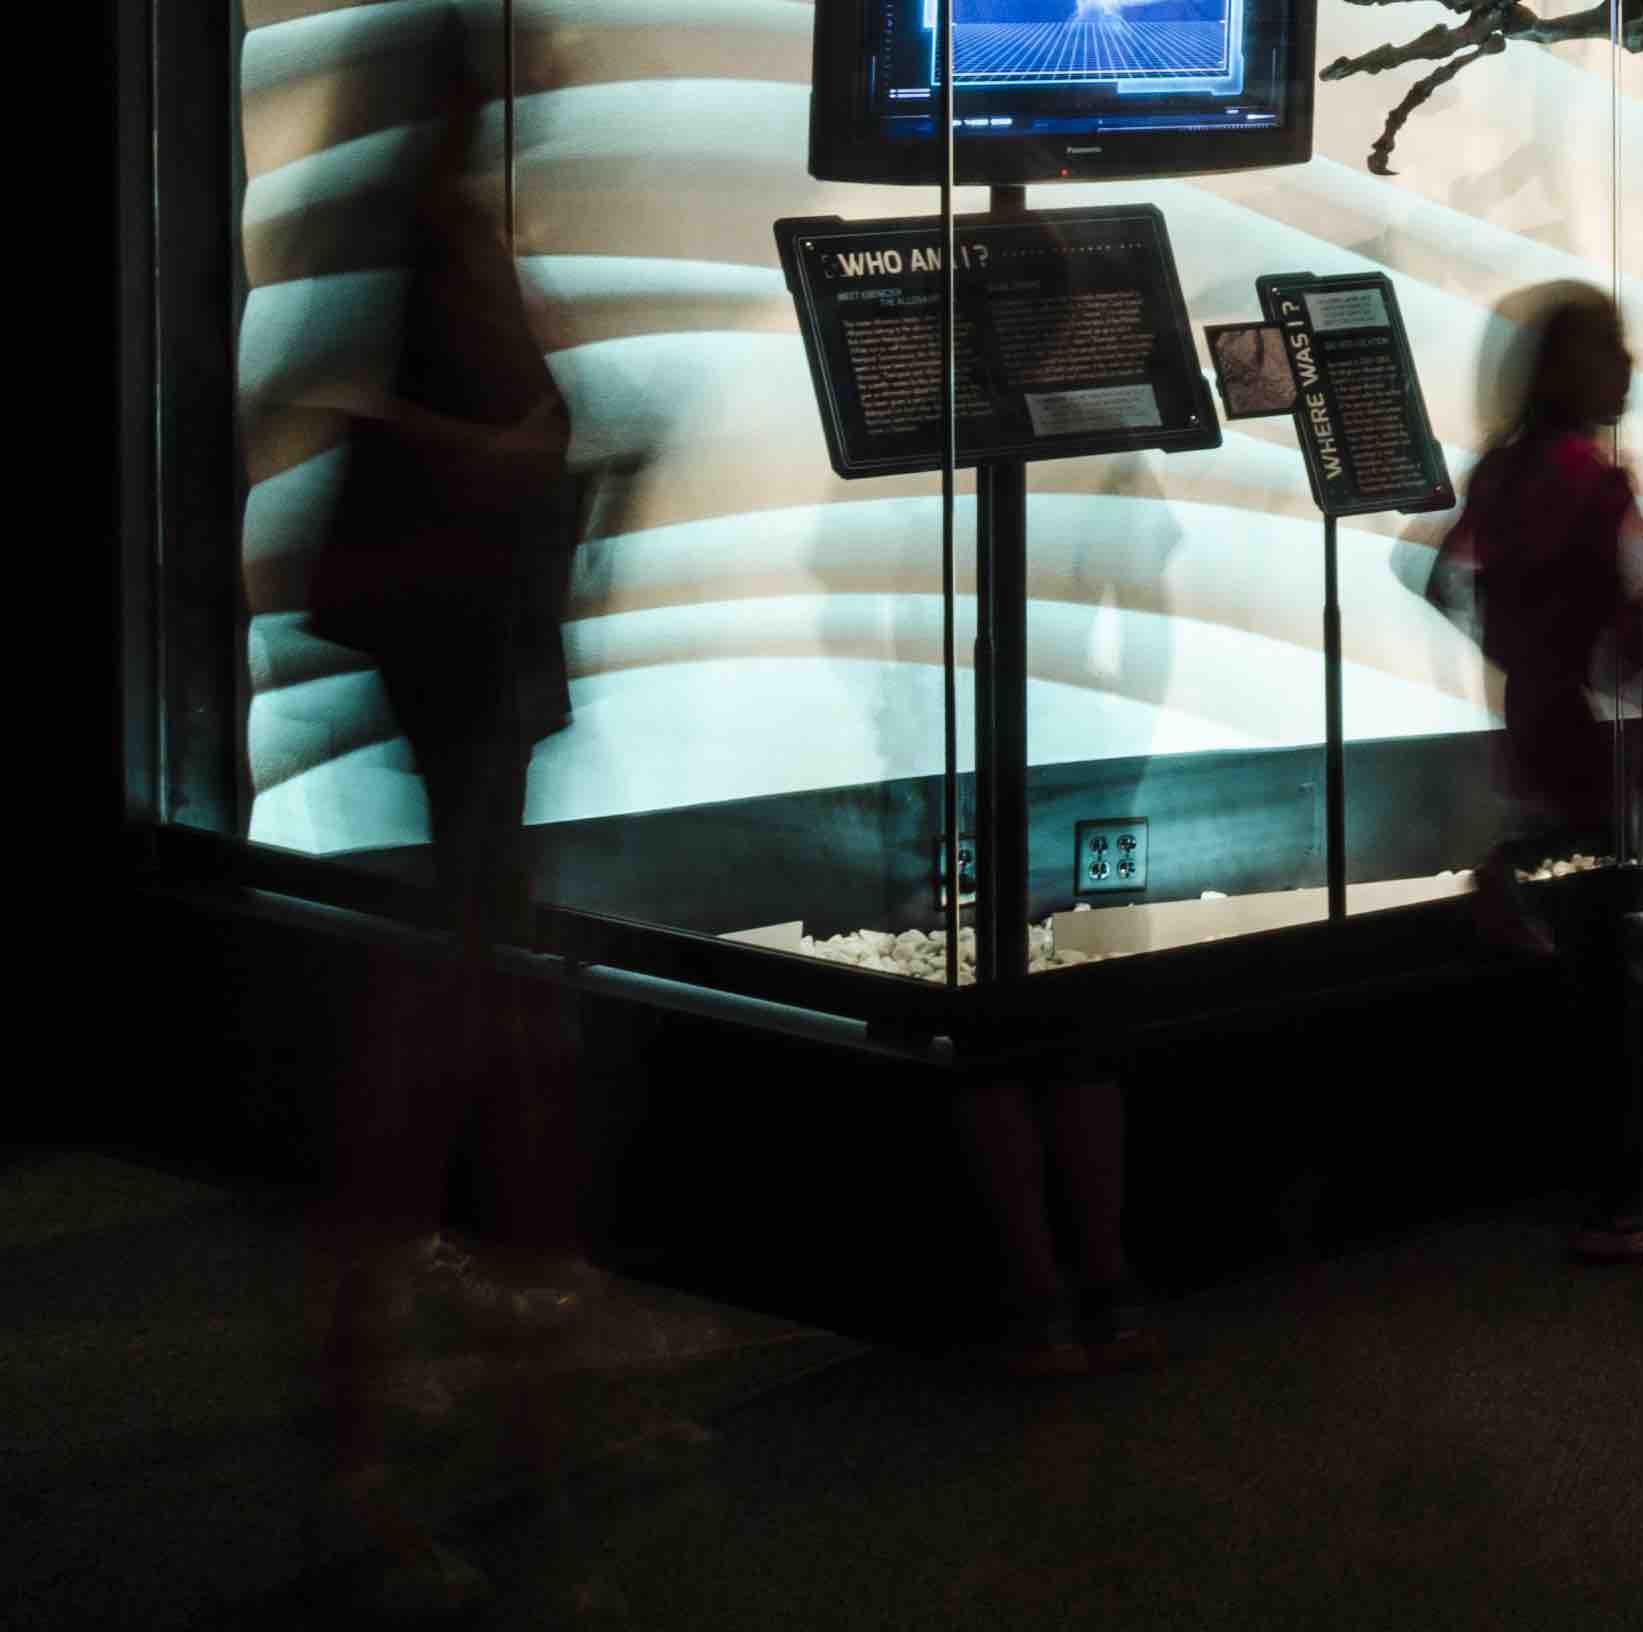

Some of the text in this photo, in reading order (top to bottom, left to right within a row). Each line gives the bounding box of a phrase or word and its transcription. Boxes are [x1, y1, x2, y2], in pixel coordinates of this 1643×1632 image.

[837, 249, 903, 277] WHO
[1290, 333, 1320, 387] WAS
[1305, 392, 1344, 480] WHERE
